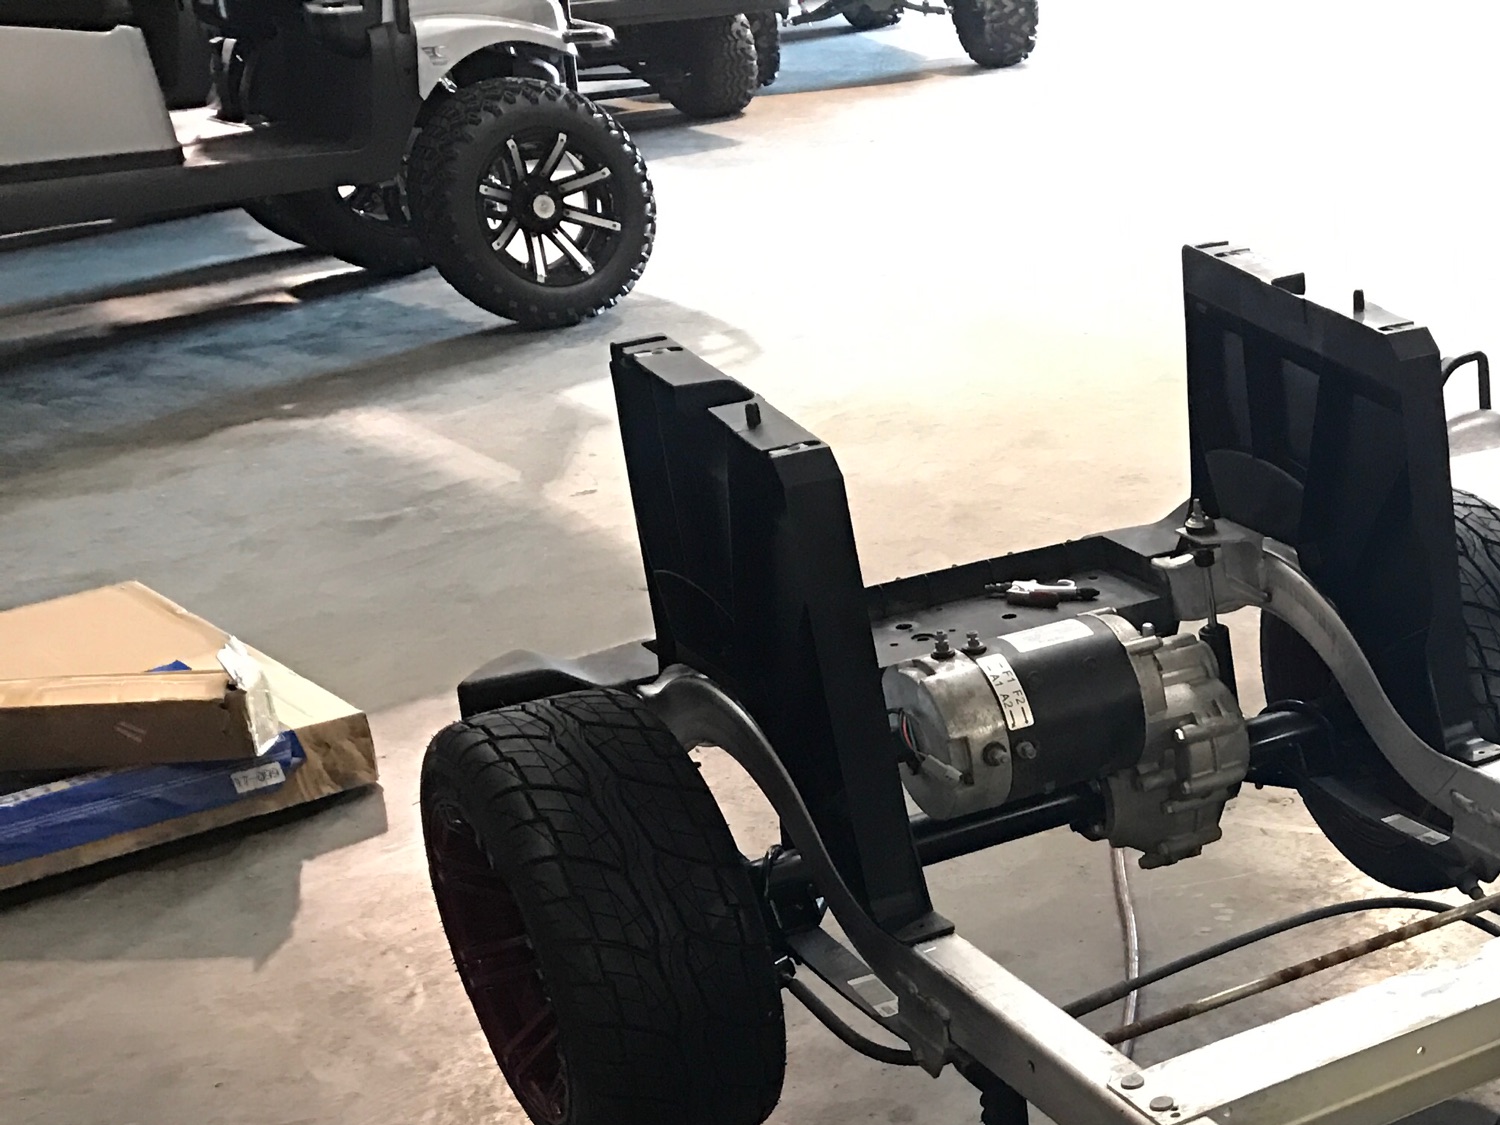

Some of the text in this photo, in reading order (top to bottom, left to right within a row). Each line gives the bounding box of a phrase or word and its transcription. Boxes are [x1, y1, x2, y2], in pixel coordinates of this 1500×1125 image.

[989, 674, 1014, 709] A1 A2
[1002, 670, 1026, 705] F1 F2
